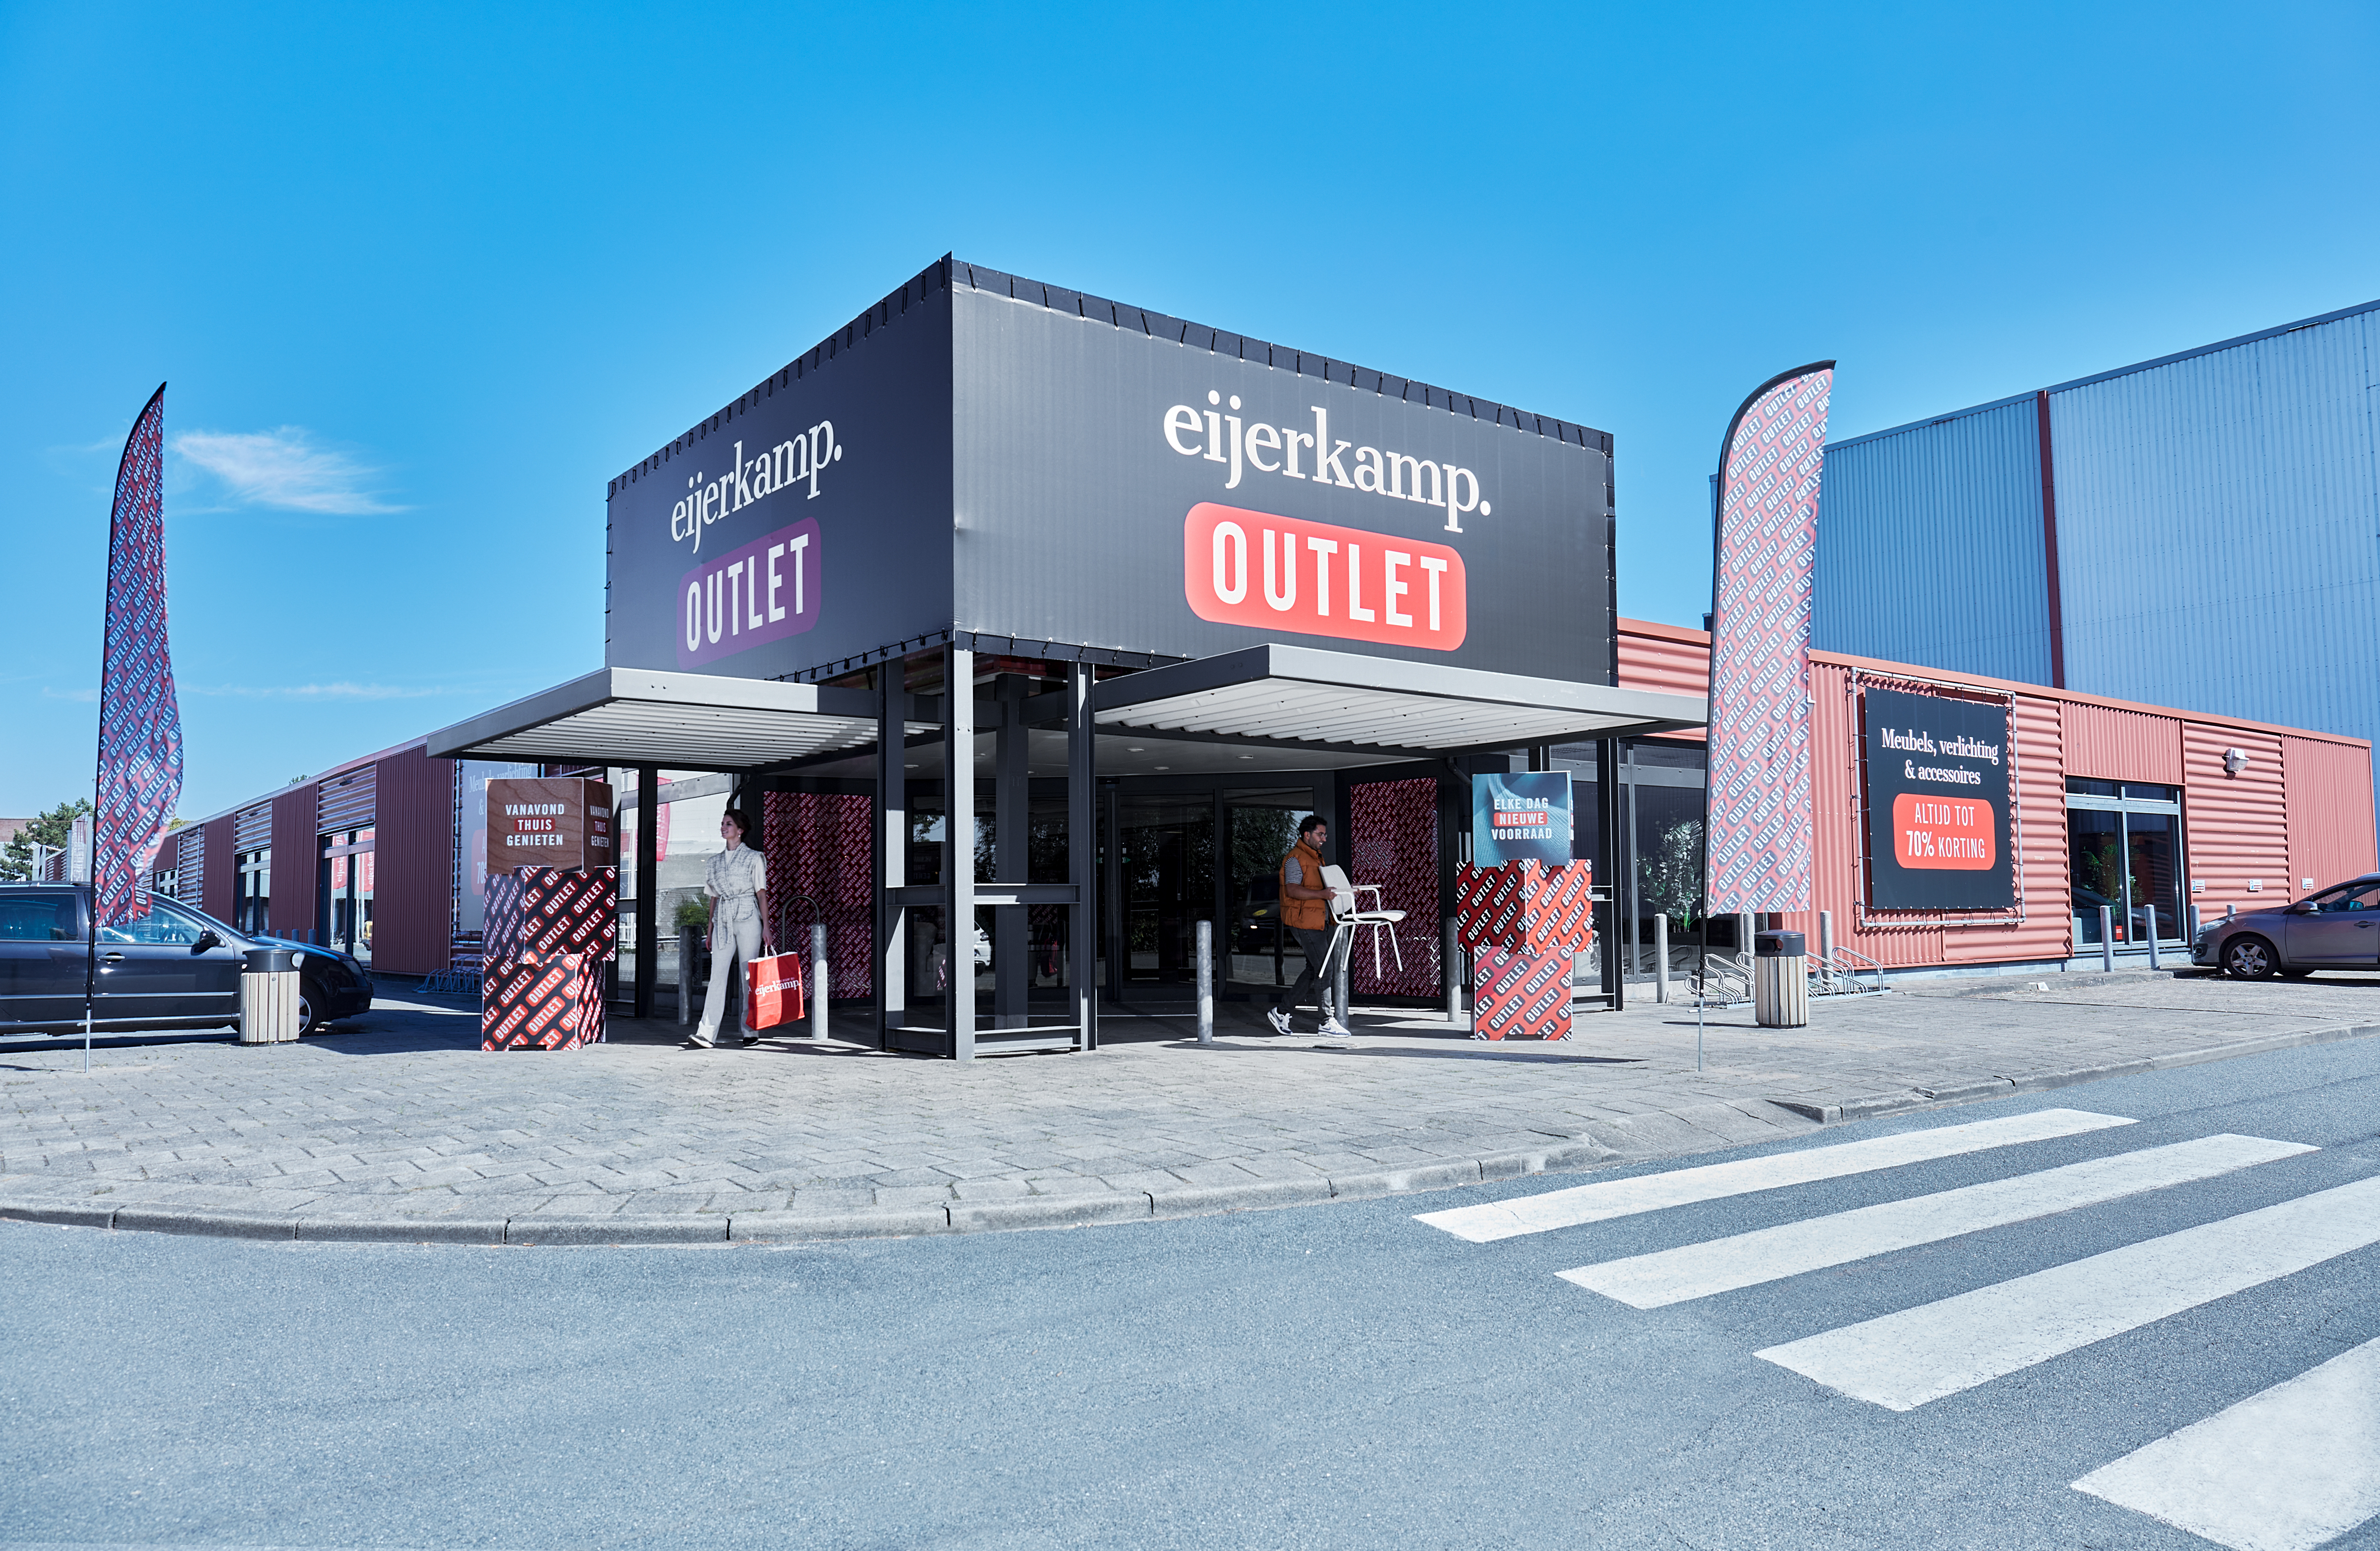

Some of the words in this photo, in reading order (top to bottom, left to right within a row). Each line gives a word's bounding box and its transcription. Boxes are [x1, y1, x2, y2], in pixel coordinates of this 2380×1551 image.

[1765, 383, 1796, 416] OUTLET
[1797, 376, 1827, 409] OUTLET
[148, 401, 162, 438] OUTLET
[1733, 417, 1760, 451] OUTLET
[1762, 410, 1792, 443] OUTLET
[1782, 412, 1812, 446] OUTLET
[133, 420, 147, 456] OUTLET
[134, 445, 147, 482] OUTLET
[144, 441, 157, 478] OUTLET
[1164, 390, 1491, 533] eijerkamp.
[1730, 445, 1757, 478] OUTLET
[1749, 447, 1778, 481] OUTLET
[1779, 439, 1808, 472] OUTLET
[129, 484, 144, 520] OUTLET
[145, 467, 158, 504] OUTLET
[672, 420, 842, 554] eijerkamp.
[1747, 474, 1775, 508] OUTLET
[1766, 477, 1794, 510] OUTLET
[115, 488, 133, 523] OUTLET
[1763, 503, 1791, 536] OUTLET
[1781, 505, 1810, 538] OUTLET
[128, 510, 145, 546] OUTLET
[142, 506, 155, 543] OUTLET
[1734, 511, 1761, 546] OUTLET
[143, 532, 156, 568] OUTLET
[1732, 538, 1759, 572] OUTLET
[1751, 541, 1777, 574] OUTLET
[1778, 531, 1807, 565] OUTLET
[121, 548, 140, 583] OUTLET
[1213, 521, 1447, 631] OUTLET
[120, 573, 140, 609] OUTLET
[135, 571, 153, 606] OUTLET
[687, 533, 809, 651] OUTLET
[1722, 576, 1746, 611] OUTLET
[1748, 567, 1774, 601] OUTLET
[1766, 569, 1793, 602] OUTLET
[108, 611, 133, 646] OUTLET
[134, 596, 154, 632] OUTLET
[1720, 603, 1744, 637] OUTLET
[1737, 604, 1762, 639] OUTLET
[1764, 595, 1791, 629] OUTLET
[107, 636, 131, 671] OUTLET
[125, 634, 148, 668] OUTLET
[1735, 631, 1760, 666] OUTLET
[1752, 633, 1780, 667] OUTLET
[123, 659, 147, 694] OUTLET
[140, 657, 162, 693] OUTLET
[1724, 669, 1749, 704] OUTLET
[1751, 658, 1779, 693] OUTLET
[1772, 659, 1800, 693] OUTLET
[112, 697, 136, 731] OUTLET
[138, 683, 162, 717] OUTLET
[1722, 696, 1748, 731] OUTLET
[1740, 696, 1769, 731] OUTLET
[1772, 686, 1798, 719] OUTLET
[111, 721, 134, 756] OUTLET
[127, 720, 153, 755] OUTLET
[154, 706, 174, 742] OUTLET
[1740, 722, 1769, 758] OUTLET
[1763, 722, 1790, 757] OUTLET
[126, 746, 152, 780] OUTLET
[143, 744, 167, 779] OUTLET
[1713, 734, 1737, 770] OUTLET
[1881, 728, 1937, 757] Meubels,
[1939, 735, 1999, 765] verlichting
[99, 758, 123, 794] OUTLET
[1713, 761, 1736, 797] OUTLET
[1729, 761, 1760, 797] OUTLET
[1763, 749, 1790, 783] OUTLET
[1786, 749, 1809, 783] OUTLET
[1905, 759, 1915, 779] &
[1918, 765, 1980, 784] accessoires
[97, 784, 122, 819] OUTLET
[116, 783, 139, 818] OUTLET
[141, 769, 167, 804] OUTLET
[764, 792, 777, 805] OUTLET
[800, 794, 812, 807] OUTLET
[1361, 789, 1370, 803] OUTLET
[1368, 789, 1377, 802] OUTLET
[1378, 783, 1387, 797] OUTLET
[1385, 782, 1395, 796] OUTLET
[1421, 778, 1431, 792] OUTLET
[1786, 775, 1810, 810] OUTLET
[505, 804, 564, 815] VANAVOND
[590, 805, 609, 818] VANAVOND
[764, 802, 776, 815] OUTLET
[839, 800, 851, 813] OUTLET
[839, 810, 851, 822] OUTLET
[1381, 806, 1392, 821] OUTLET
[1494, 799, 1521, 810] ELKE
[1527, 797, 1548, 809] DAG
[1499, 813, 1544, 824] NIEUWE
[1729, 787, 1760, 824] OUTLET
[1753, 786, 1784, 823] OUTLET
[1915, 803, 1950, 825] ALTIJD
[1955, 805, 1974, 826] TOT
[115, 808, 137, 843] OUTLET
[131, 807, 159, 842] OUTLET
[506, 834, 563, 846] GENIETEN
[517, 819, 552, 830] THUIS
[591, 835, 609, 847] GENIETEN
[594, 821, 606, 832] THUIS
[803, 818, 816, 831] OUTLET
[1491, 828, 1552, 840] VOORRAAD
[1754, 813, 1785, 850] OUTLET
[1779, 813, 1802, 849] OUTLET
[1718, 826, 1750, 863] OUTLET
[1779, 839, 1804, 875] OUTLET
[1906, 830, 1935, 857] 70%
[1938, 837, 1985, 858] KORTING
[106, 845, 128, 880] OUTLET
[1719, 852, 1750, 890] OUTLET
[1743, 852, 1775, 889] OUTLET
[102, 870, 127, 905] OUTLET
[491, 883, 506, 915] OUTLET
[504, 882, 519, 914] OUTLET
[545, 881, 575, 914] OUTLET
[574, 881, 604, 914] OUTLET
[1472, 874, 1495, 907] OUTLET
[1494, 874, 1516, 906] OUTLET
[1542, 874, 1563, 907] OUTLET
[1562, 873, 1583, 906] OUTLET
[488, 917, 502, 950] OUTLET
[502, 910, 518, 943] OUTLET
[539, 916, 570, 950] OUTLET
[573, 909, 603, 942] OUTLET
[1468, 909, 1491, 940] OUTLET
[1493, 902, 1517, 934] OUTLET
[1537, 909, 1561, 941] OUTLET
[1562, 902, 1584, 934] OUTLET
[841, 955, 853, 968] OUTLET
[1407, 940, 1418, 954] OUTLET
[849, 964, 861, 977] OUTLET
[858, 973, 870, 986] OUTLET
[1362, 965, 1371, 977] OUTLET
[1422, 960, 1432, 974] OUTLET
[1496, 961, 1528, 994] OUTLET
[1526, 961, 1558, 993] OUTLET
[500, 970, 531, 1004] OUTLET
[529, 970, 562, 1003] OUTLET
[584, 969, 594, 1001] OUTLET
[755, 980, 801, 997] eijerkamp.
[1393, 980, 1403, 993] OUTLET
[495, 1006, 525, 1039] OUTLET
[529, 998, 562, 1032] OUTLET
[581, 1002, 592, 1036] OUTLET
[592, 994, 603, 1026] OUTLET
[1491, 996, 1523, 1029] OUTLET
[1526, 989, 1558, 1022] OUTLET
